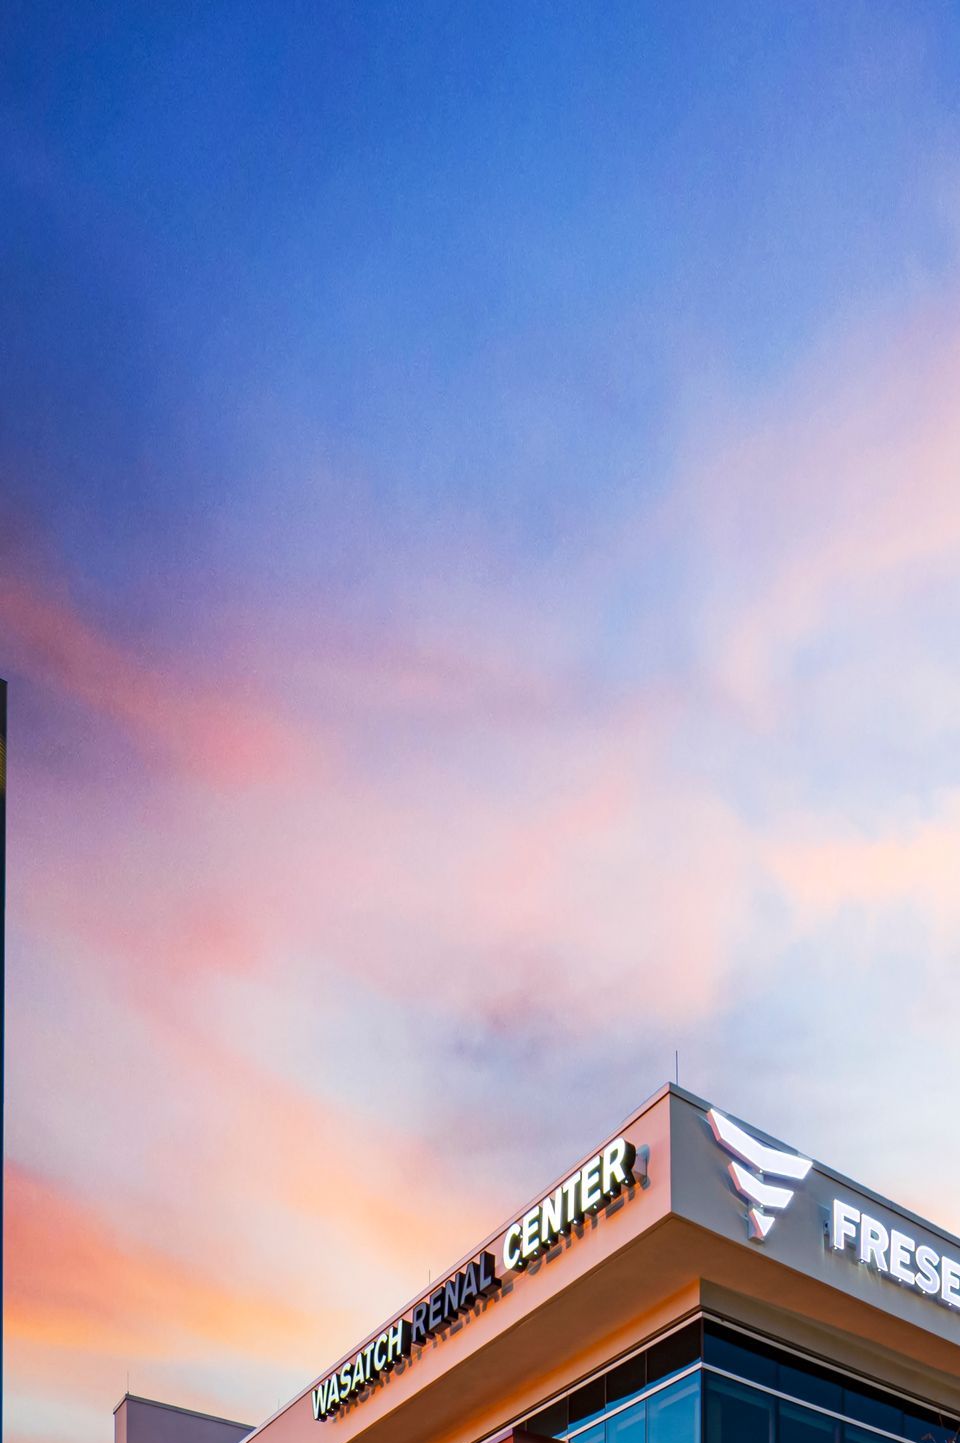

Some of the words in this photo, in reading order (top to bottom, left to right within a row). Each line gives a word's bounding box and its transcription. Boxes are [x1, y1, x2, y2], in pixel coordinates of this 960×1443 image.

[312, 1319, 405, 1421] WASATCH
[412, 1251, 496, 1345] RENAL
[502, 1137, 630, 1273] CENTER
